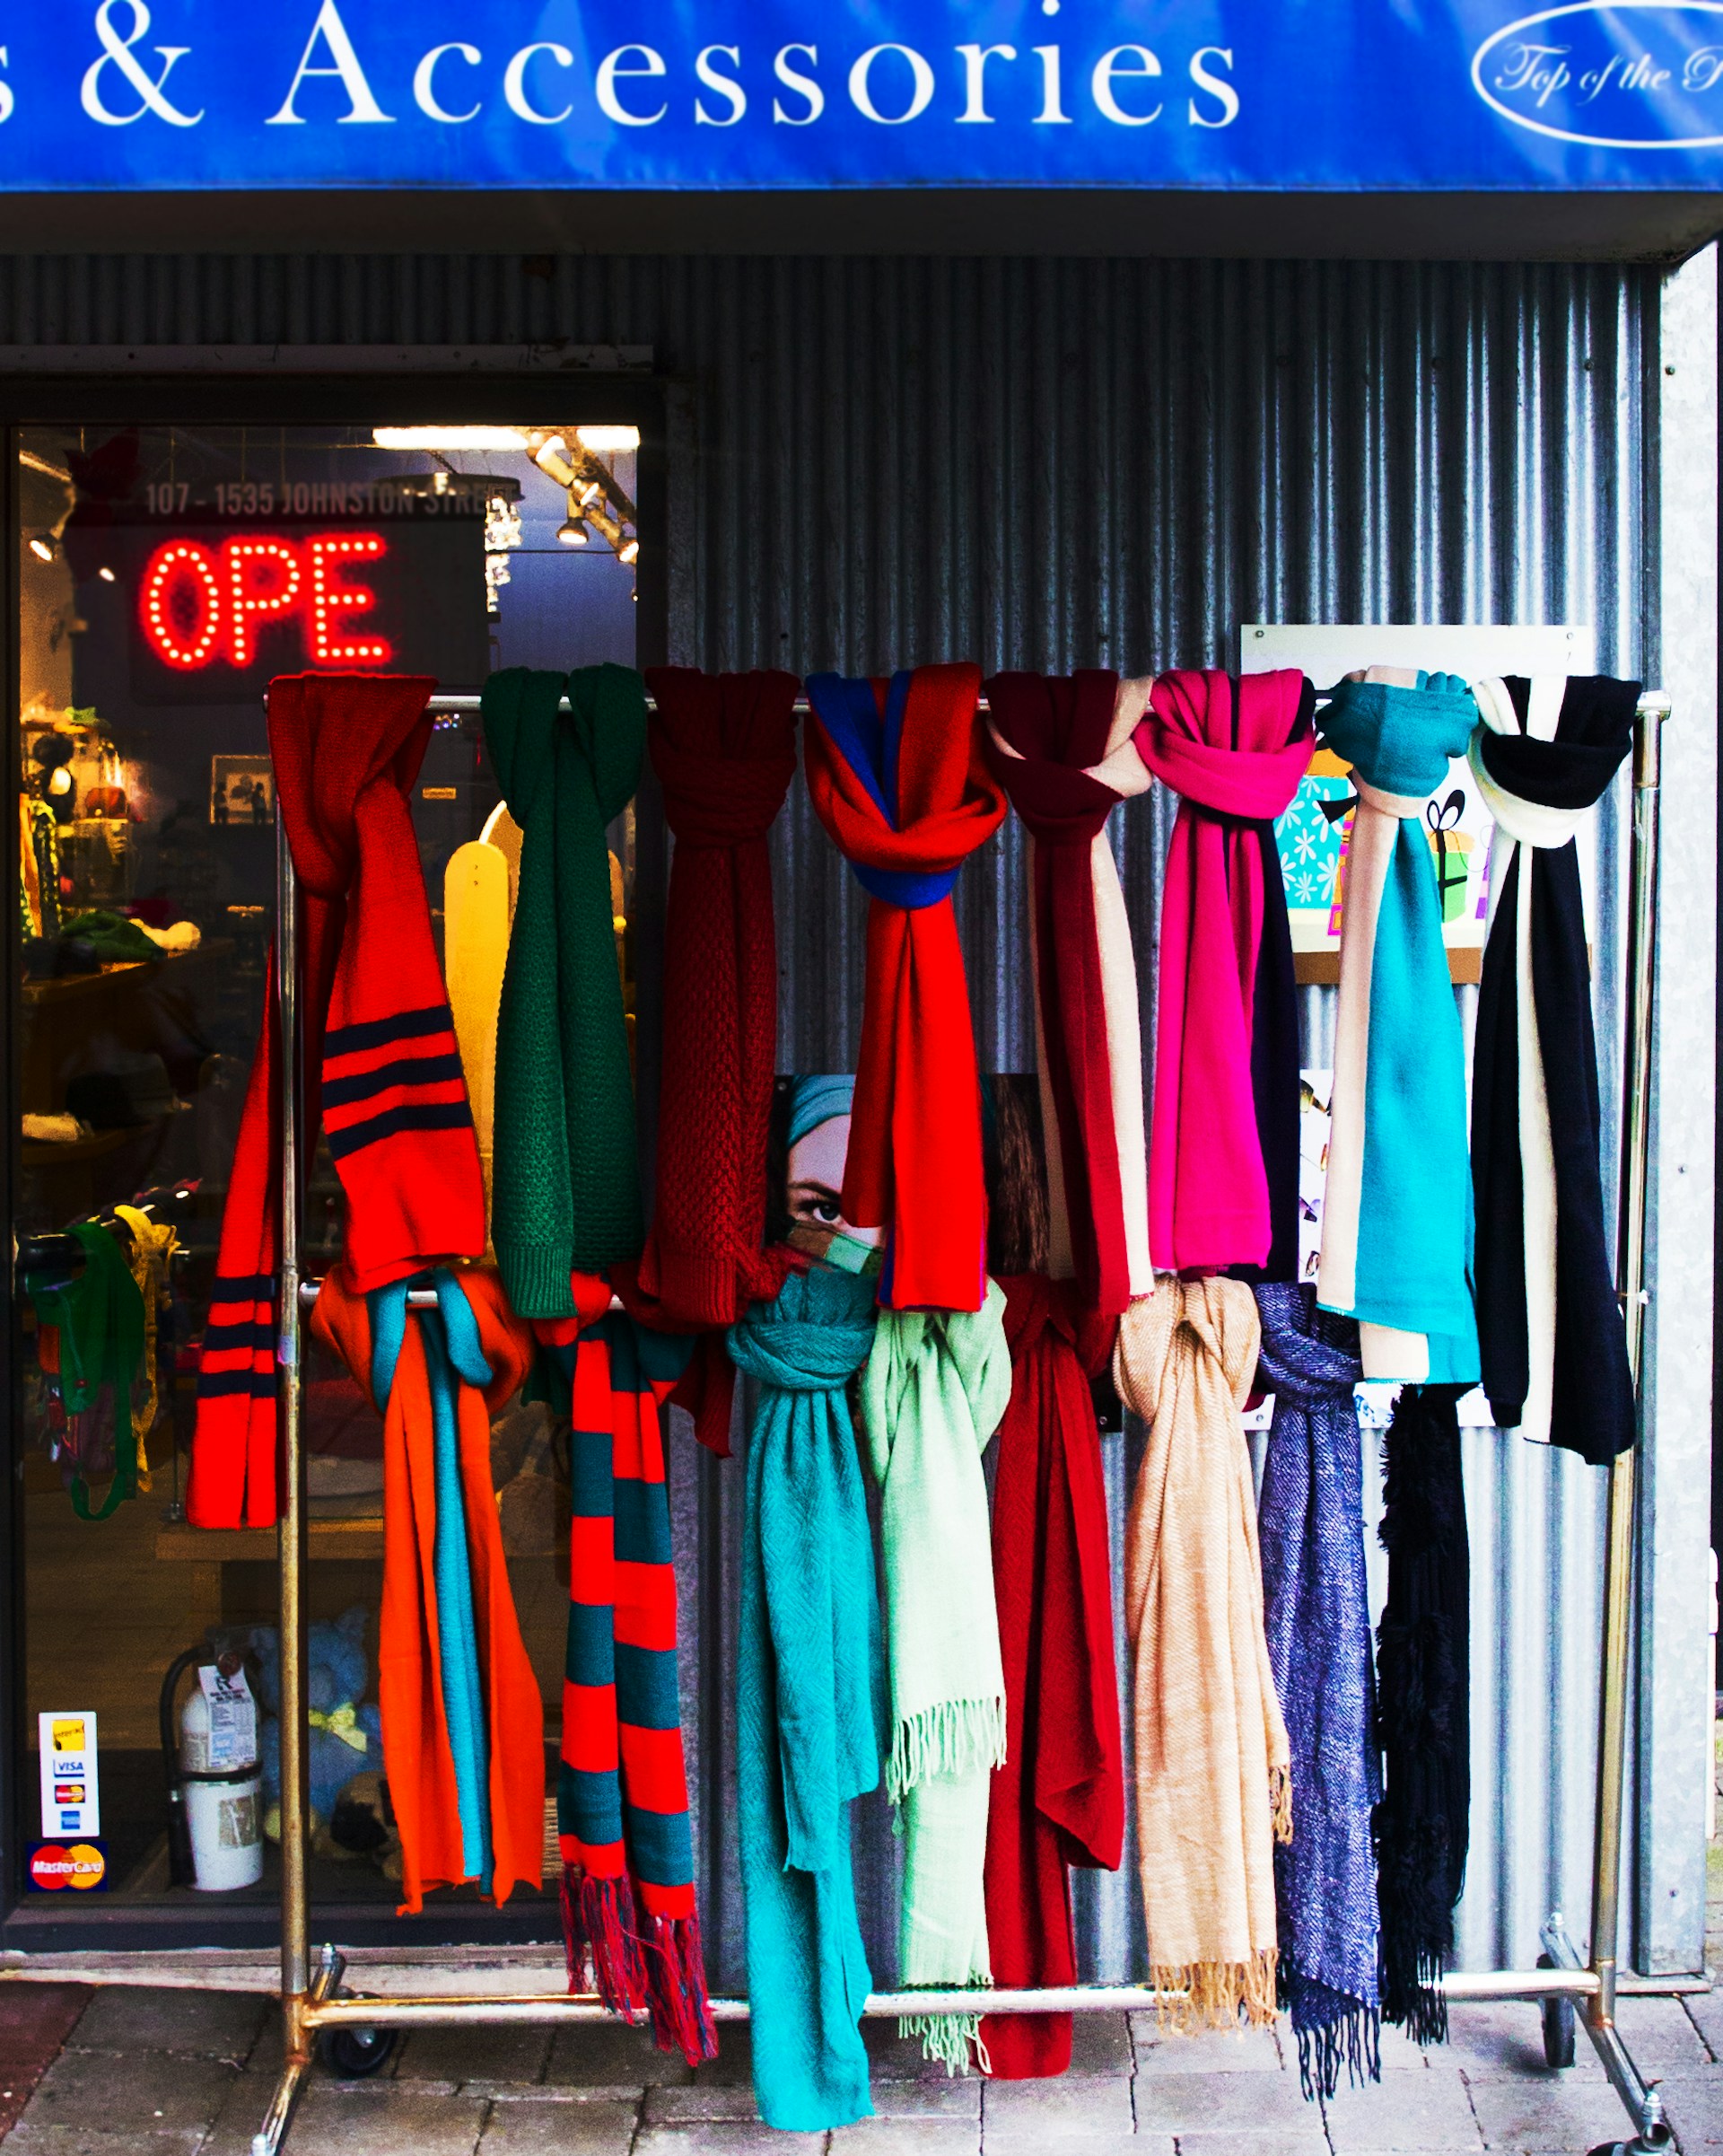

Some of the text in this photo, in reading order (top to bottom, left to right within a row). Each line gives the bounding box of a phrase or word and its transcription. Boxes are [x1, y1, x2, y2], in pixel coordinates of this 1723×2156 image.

[80, 0, 205, 127] &
[265, 0, 1240, 127] Accessories
[1494, 42, 1571, 108] Top
[1579, 54, 1623, 106] of
[1618, 54, 1671, 89] the
[146, 483, 188, 514] 107
[214, 483, 274, 514] 1535
[283, 483, 414, 515] JOHNSTON
[58, 1762, 83, 1771] VISA
[32, 1861, 102, 1874] MasterCard
